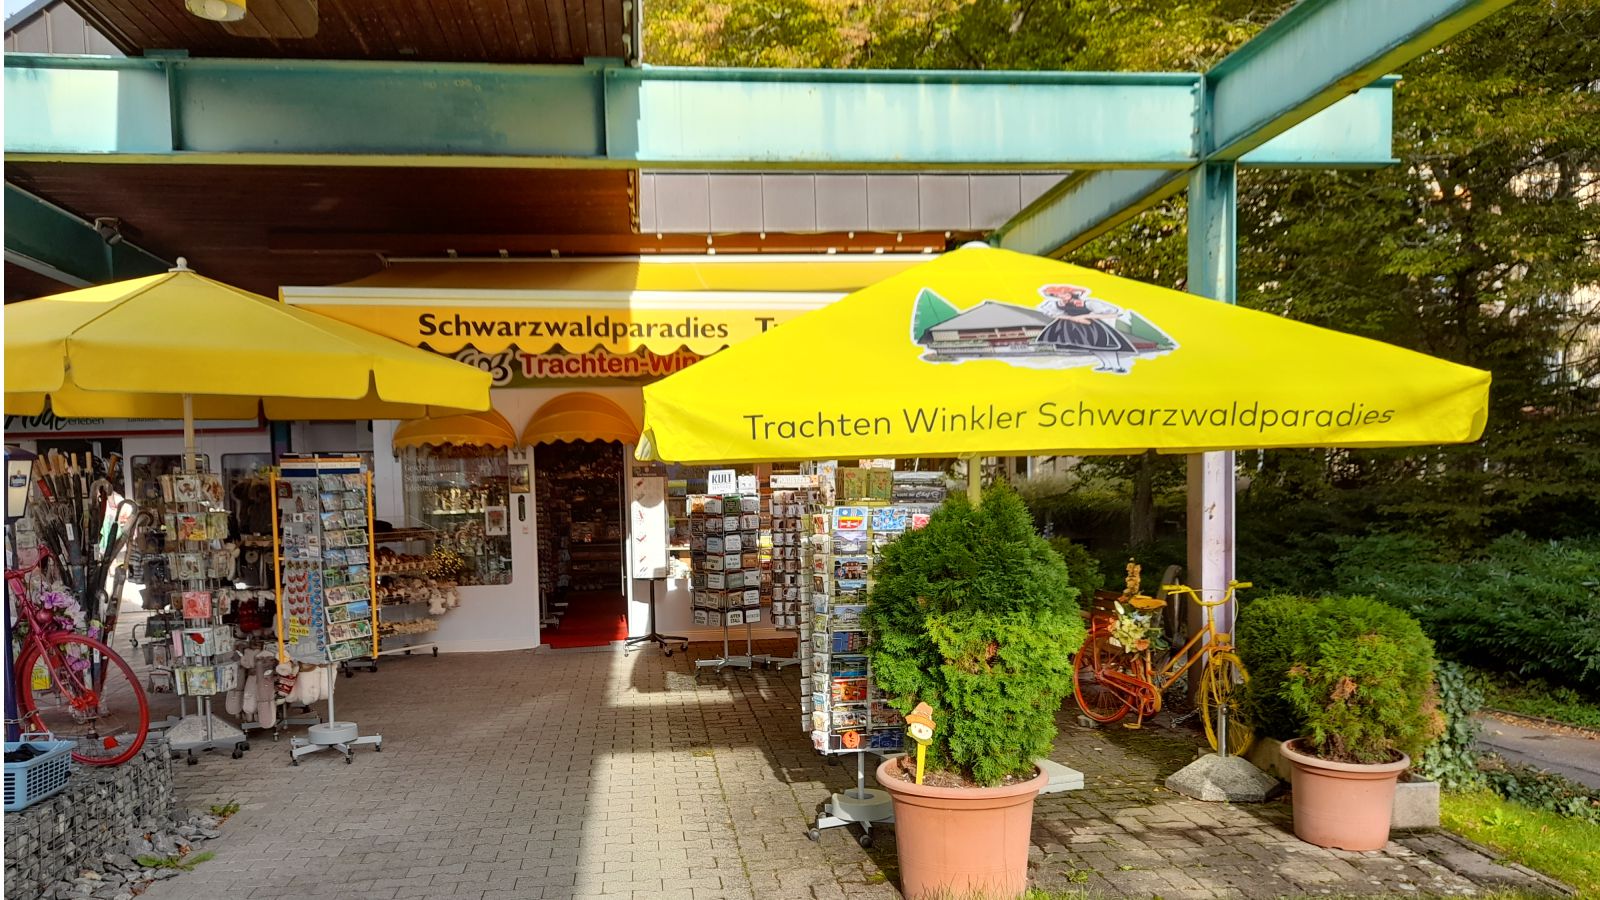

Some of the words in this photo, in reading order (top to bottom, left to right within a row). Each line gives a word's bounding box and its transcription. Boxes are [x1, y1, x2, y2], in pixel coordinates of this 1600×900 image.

[418, 313, 729, 344] Schwarzwaldparadies
[743, 411, 891, 440] Trachten
[903, 404, 1027, 433] Winkler
[1037, 401, 1395, 432] Schwarzwaldparadies
[711, 473, 732, 483] KULT
